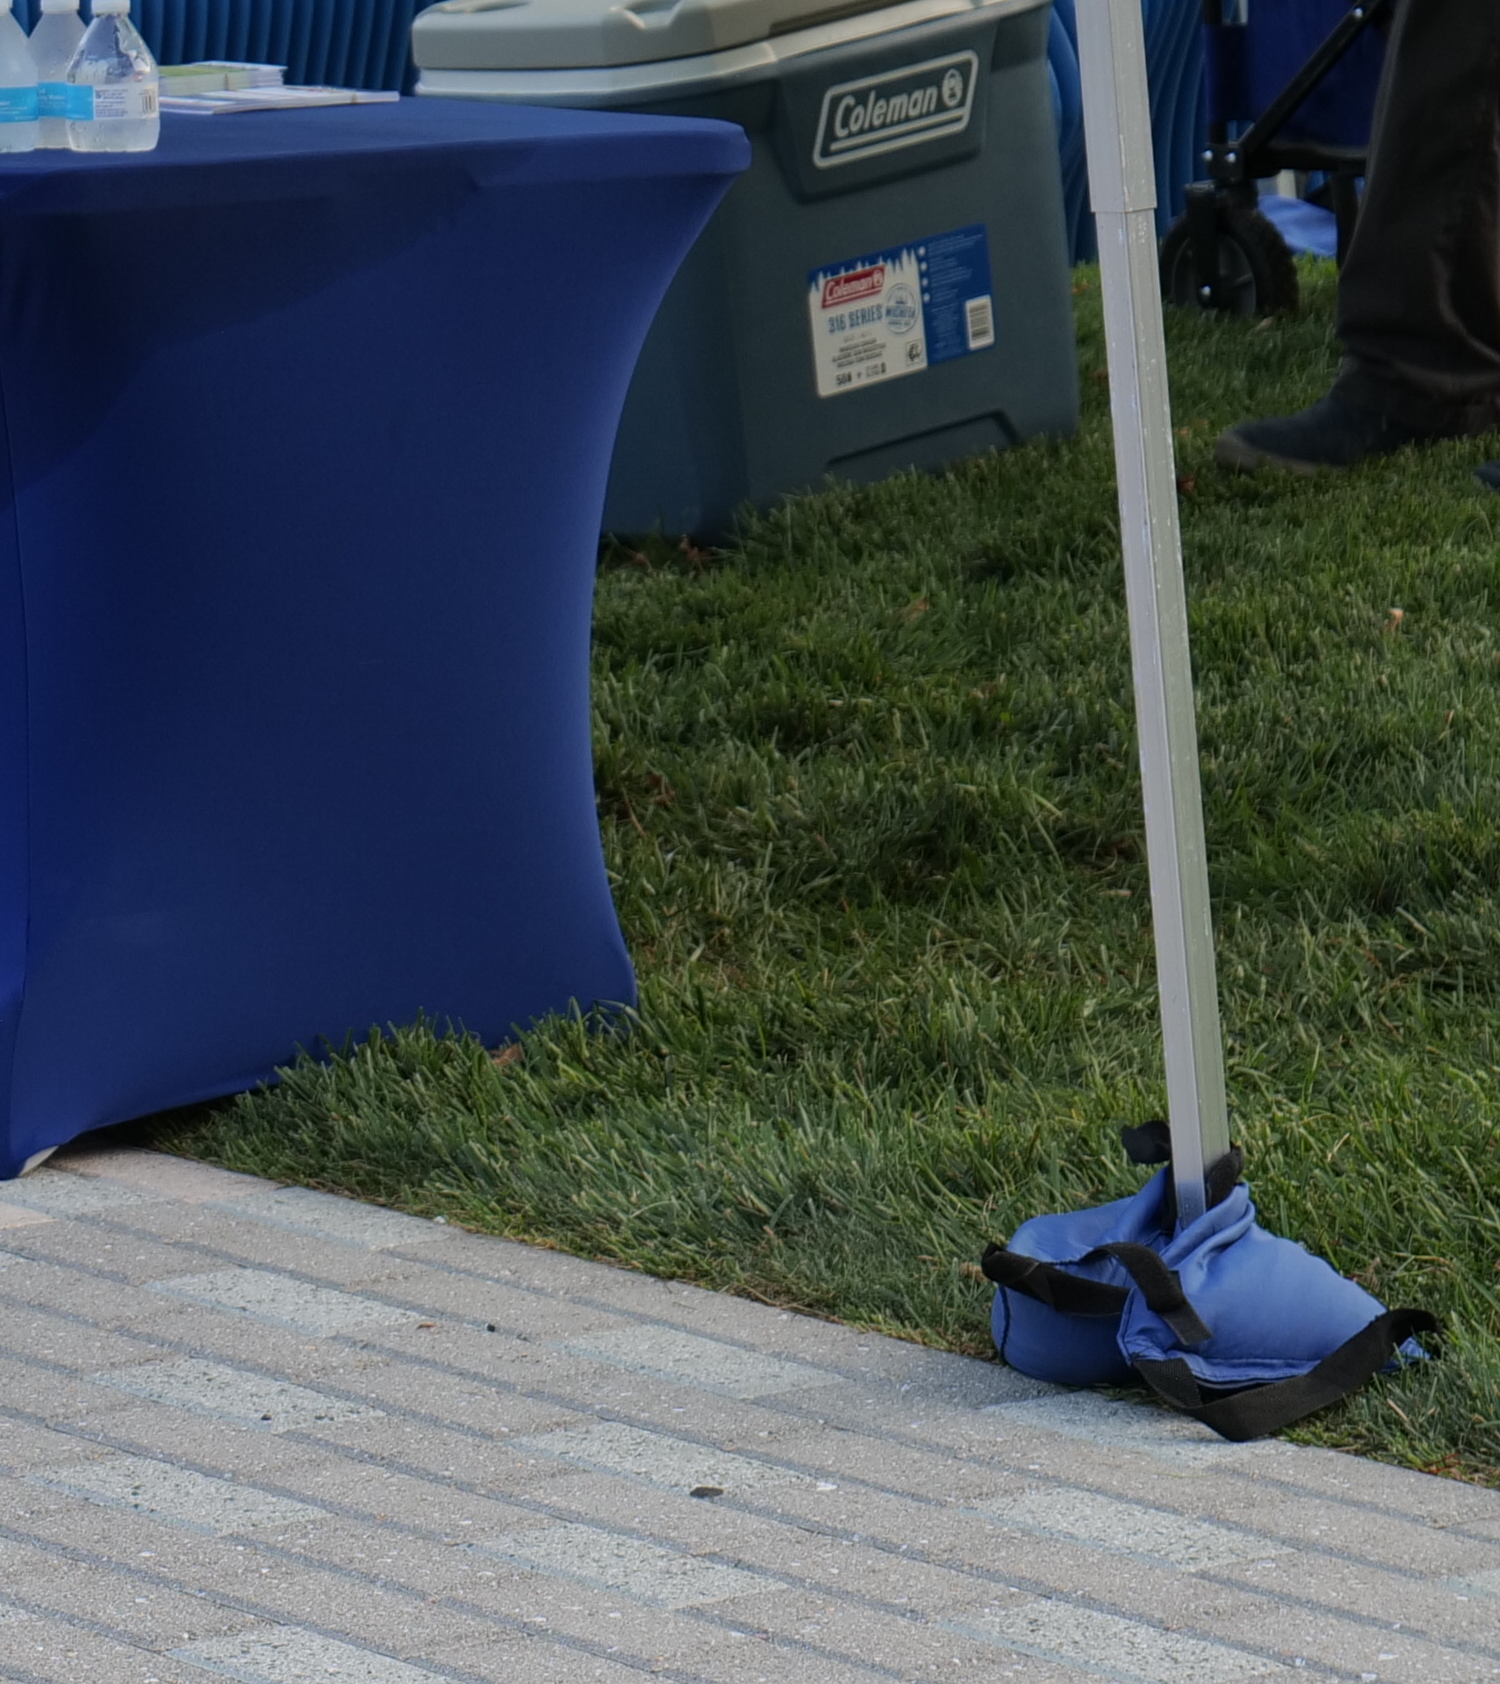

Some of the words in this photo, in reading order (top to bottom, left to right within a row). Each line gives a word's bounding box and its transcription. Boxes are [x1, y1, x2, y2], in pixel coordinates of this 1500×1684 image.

[834, 84, 939, 139] Coleman
[826, 276, 873, 301] Coleman
[848, 304, 883, 328] SERIES
